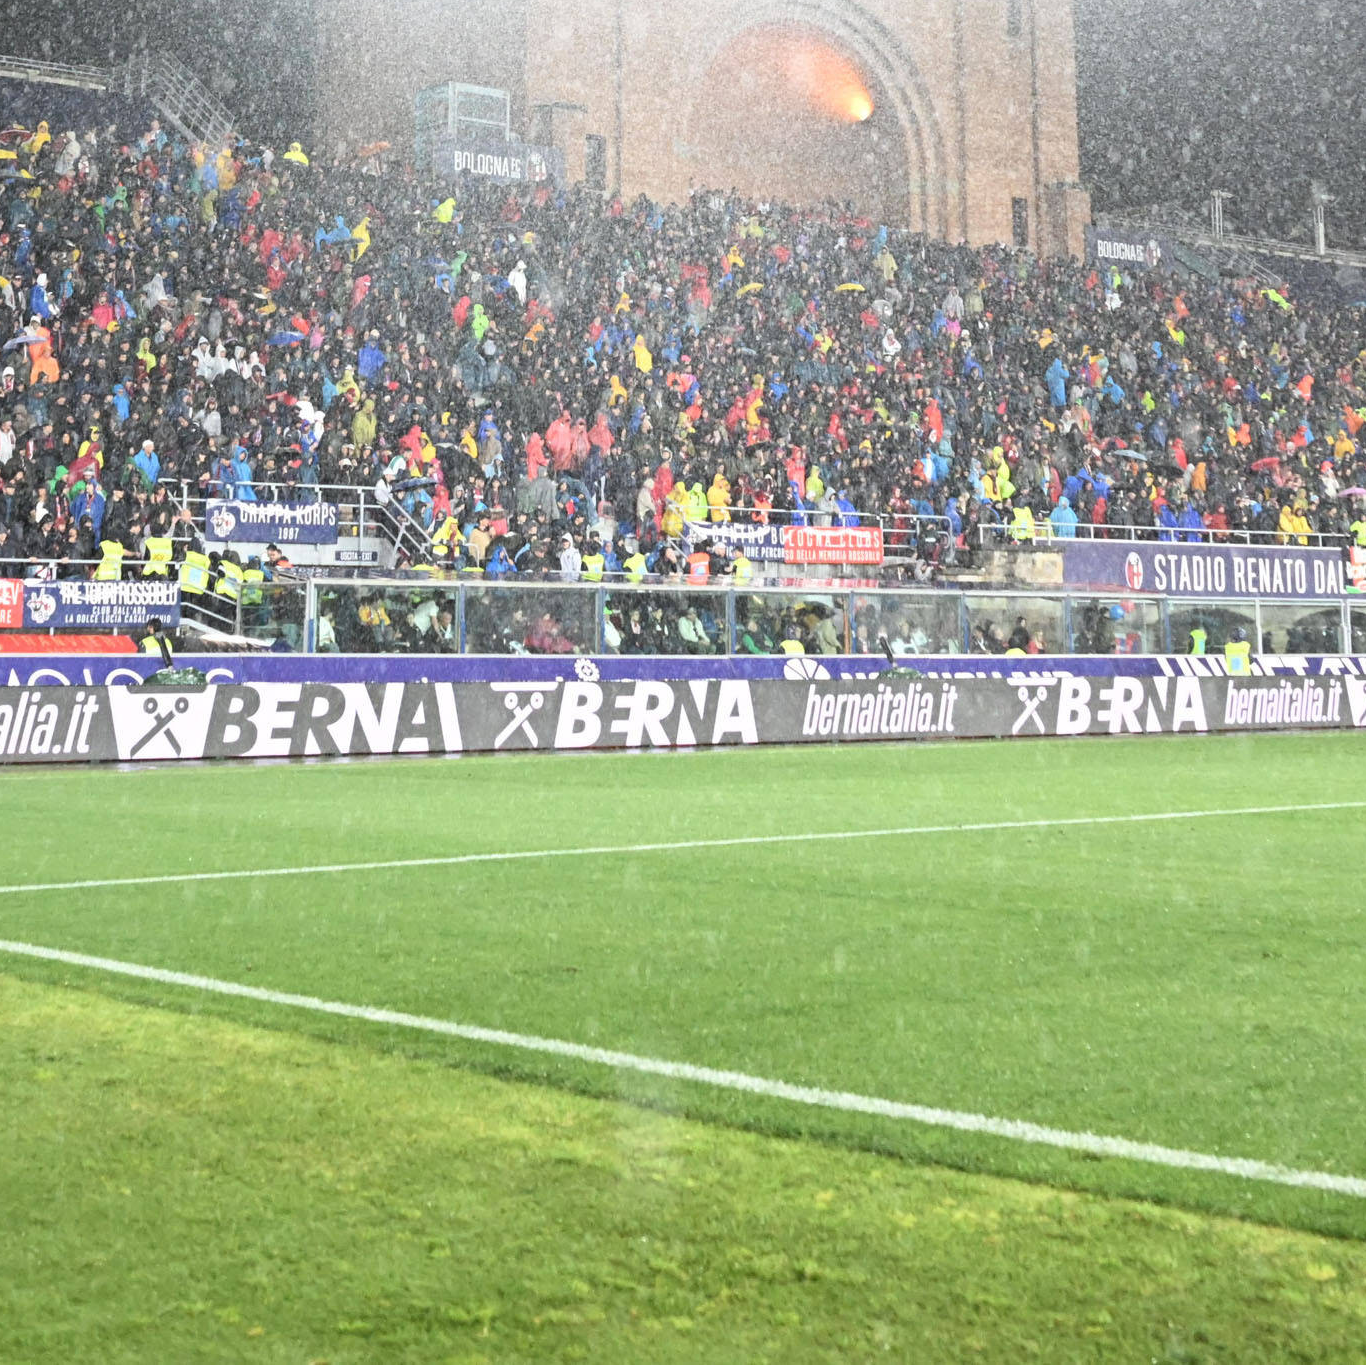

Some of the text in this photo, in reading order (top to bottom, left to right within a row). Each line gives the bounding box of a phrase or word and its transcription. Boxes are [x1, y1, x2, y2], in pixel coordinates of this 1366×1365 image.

[454, 150, 511, 177] BOLOGNA
[1097, 239, 1136, 262] BOLOGNA
[1154, 553, 1226, 592] STADIO
[1234, 556, 1306, 594] RENATO
[204, 681, 445, 757] BERNA
[554, 678, 760, 750] BERNA
[802, 682, 959, 736] bernaitalia.it
[1056, 675, 1209, 736] BERNA
[1223, 678, 1344, 726] bernaitalia.it
